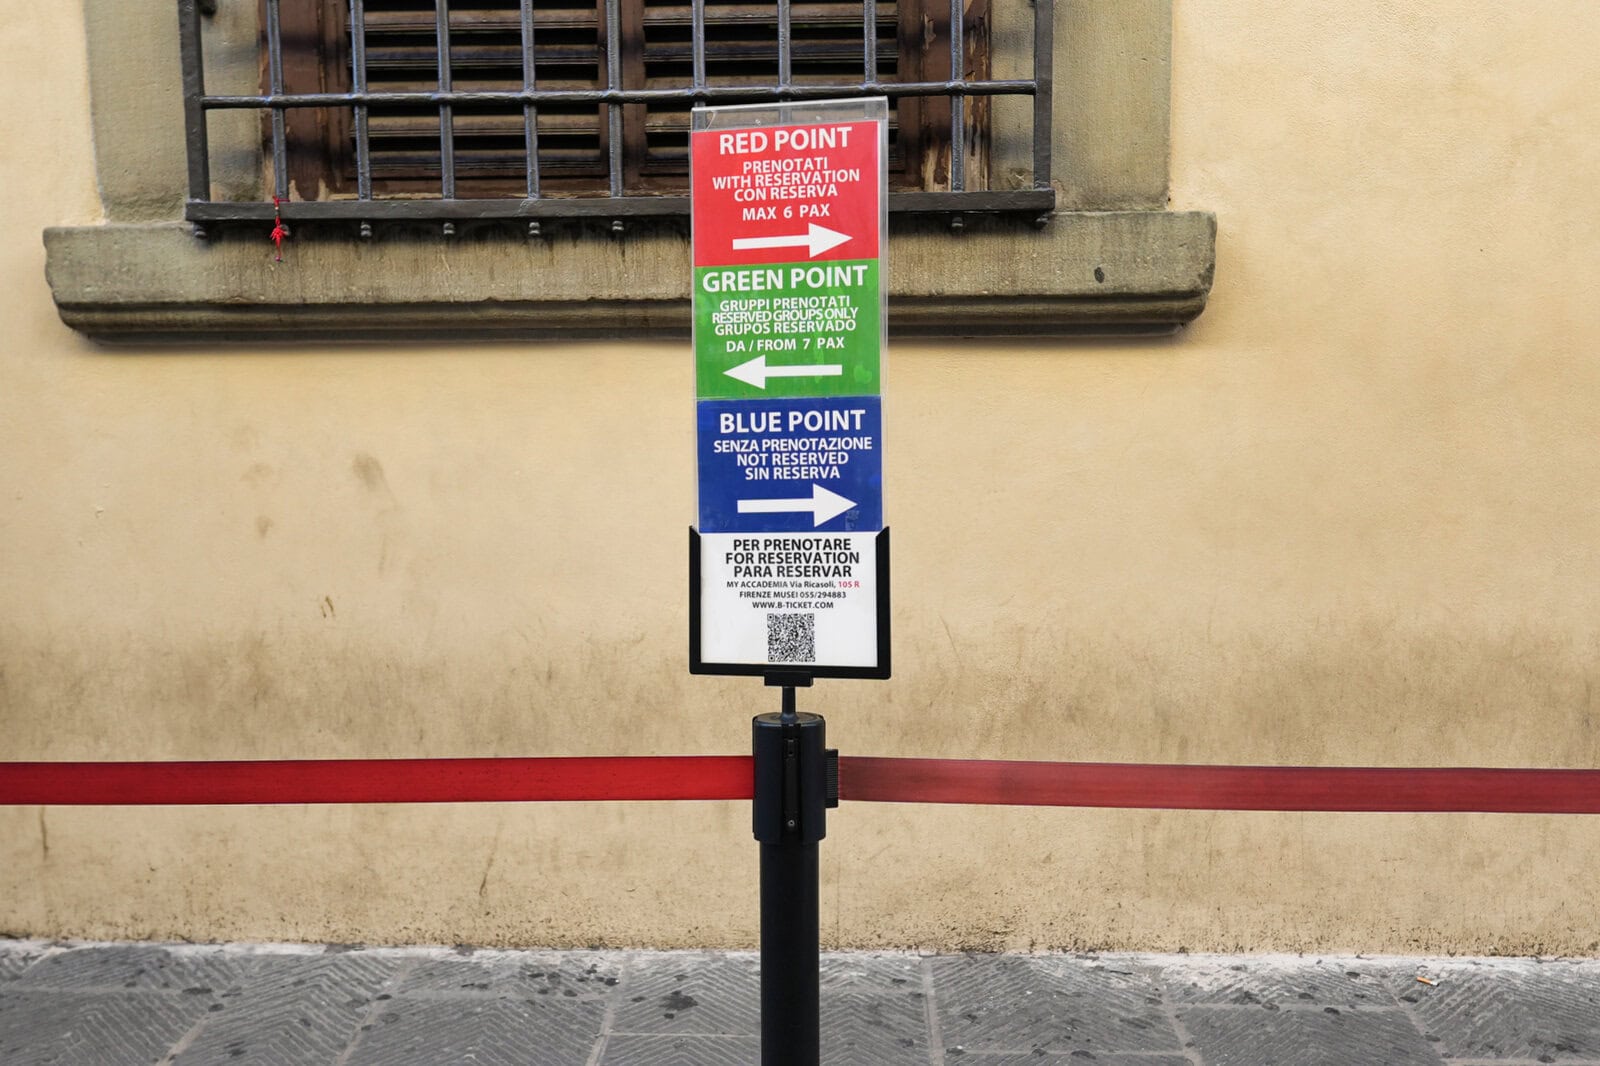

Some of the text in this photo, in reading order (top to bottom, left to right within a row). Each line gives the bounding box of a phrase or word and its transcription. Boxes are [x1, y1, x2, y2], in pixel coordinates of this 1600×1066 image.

[719, 127, 852, 155] RED POINT
[743, 157, 828, 174] PRENOTATI
[712, 169, 860, 189] WITH RESERVATION
[734, 184, 838, 201] CON RESERVA
[743, 204, 830, 221] MAX 6 PAX
[703, 265, 868, 292] GREEN POINT
[720, 296, 850, 312] GRUPPI PRENOTATI
[712, 307, 858, 323] RESERVED GROUPS ONLY
[715, 320, 856, 336] GRUPOS RESERVADO
[726, 341, 745, 352] DA
[757, 339, 796, 351] FROM
[803, 339, 810, 349] 7
[817, 337, 845, 349] PAX
[720, 410, 865, 433] BLUE POINT
[714, 437, 872, 452] SENZA PRENOTAZIONE
[737, 452, 848, 466] NOT RESERVED
[745, 466, 840, 480] SIN RESERVA
[734, 538, 851, 551] PER PRENOTARE
[726, 552, 859, 564] FOR RESERVATION
[734, 565, 852, 578] PARA RESERVAR
